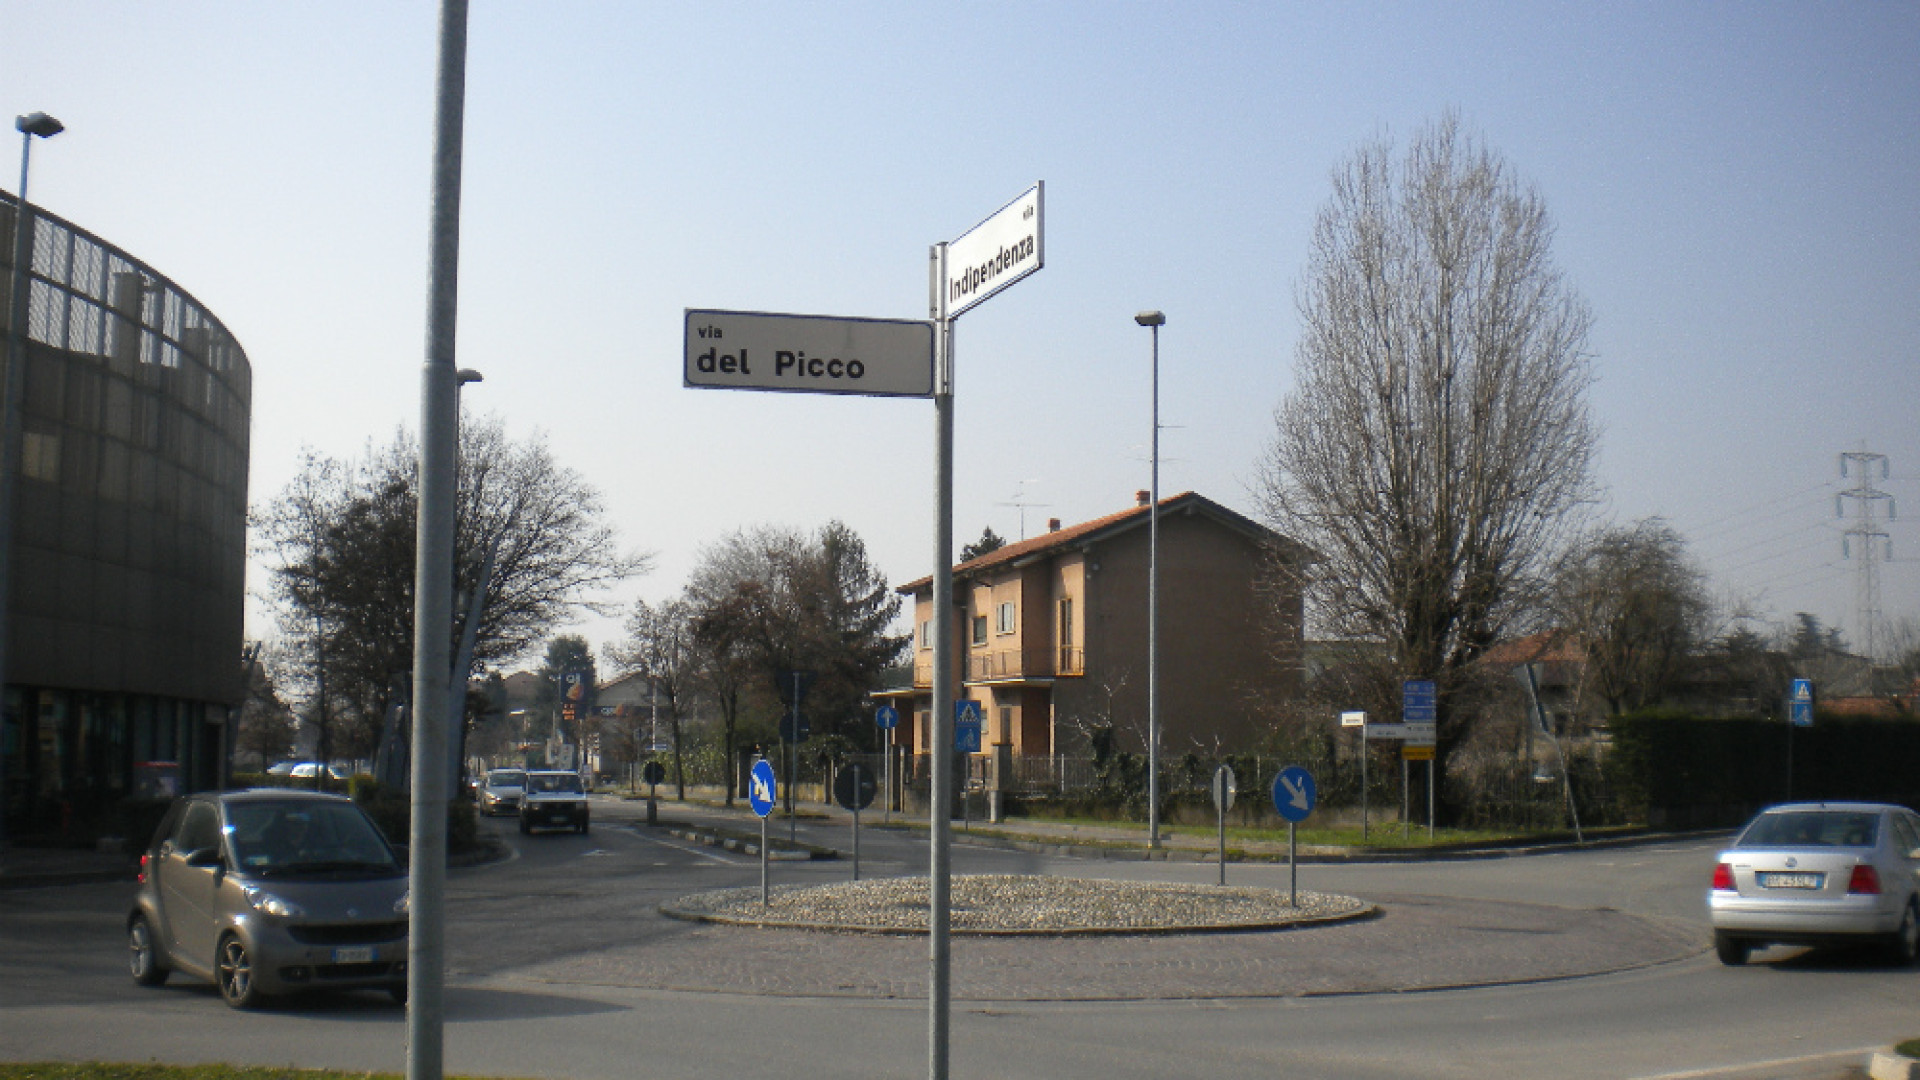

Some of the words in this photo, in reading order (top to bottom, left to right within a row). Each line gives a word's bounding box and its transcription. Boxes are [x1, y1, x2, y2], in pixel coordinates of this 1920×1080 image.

[1022, 204, 1034, 221] via
[949, 233, 1034, 303] Indipendenza
[697, 324, 723, 339] via
[697, 346, 751, 374] del
[774, 350, 865, 379] Picco
